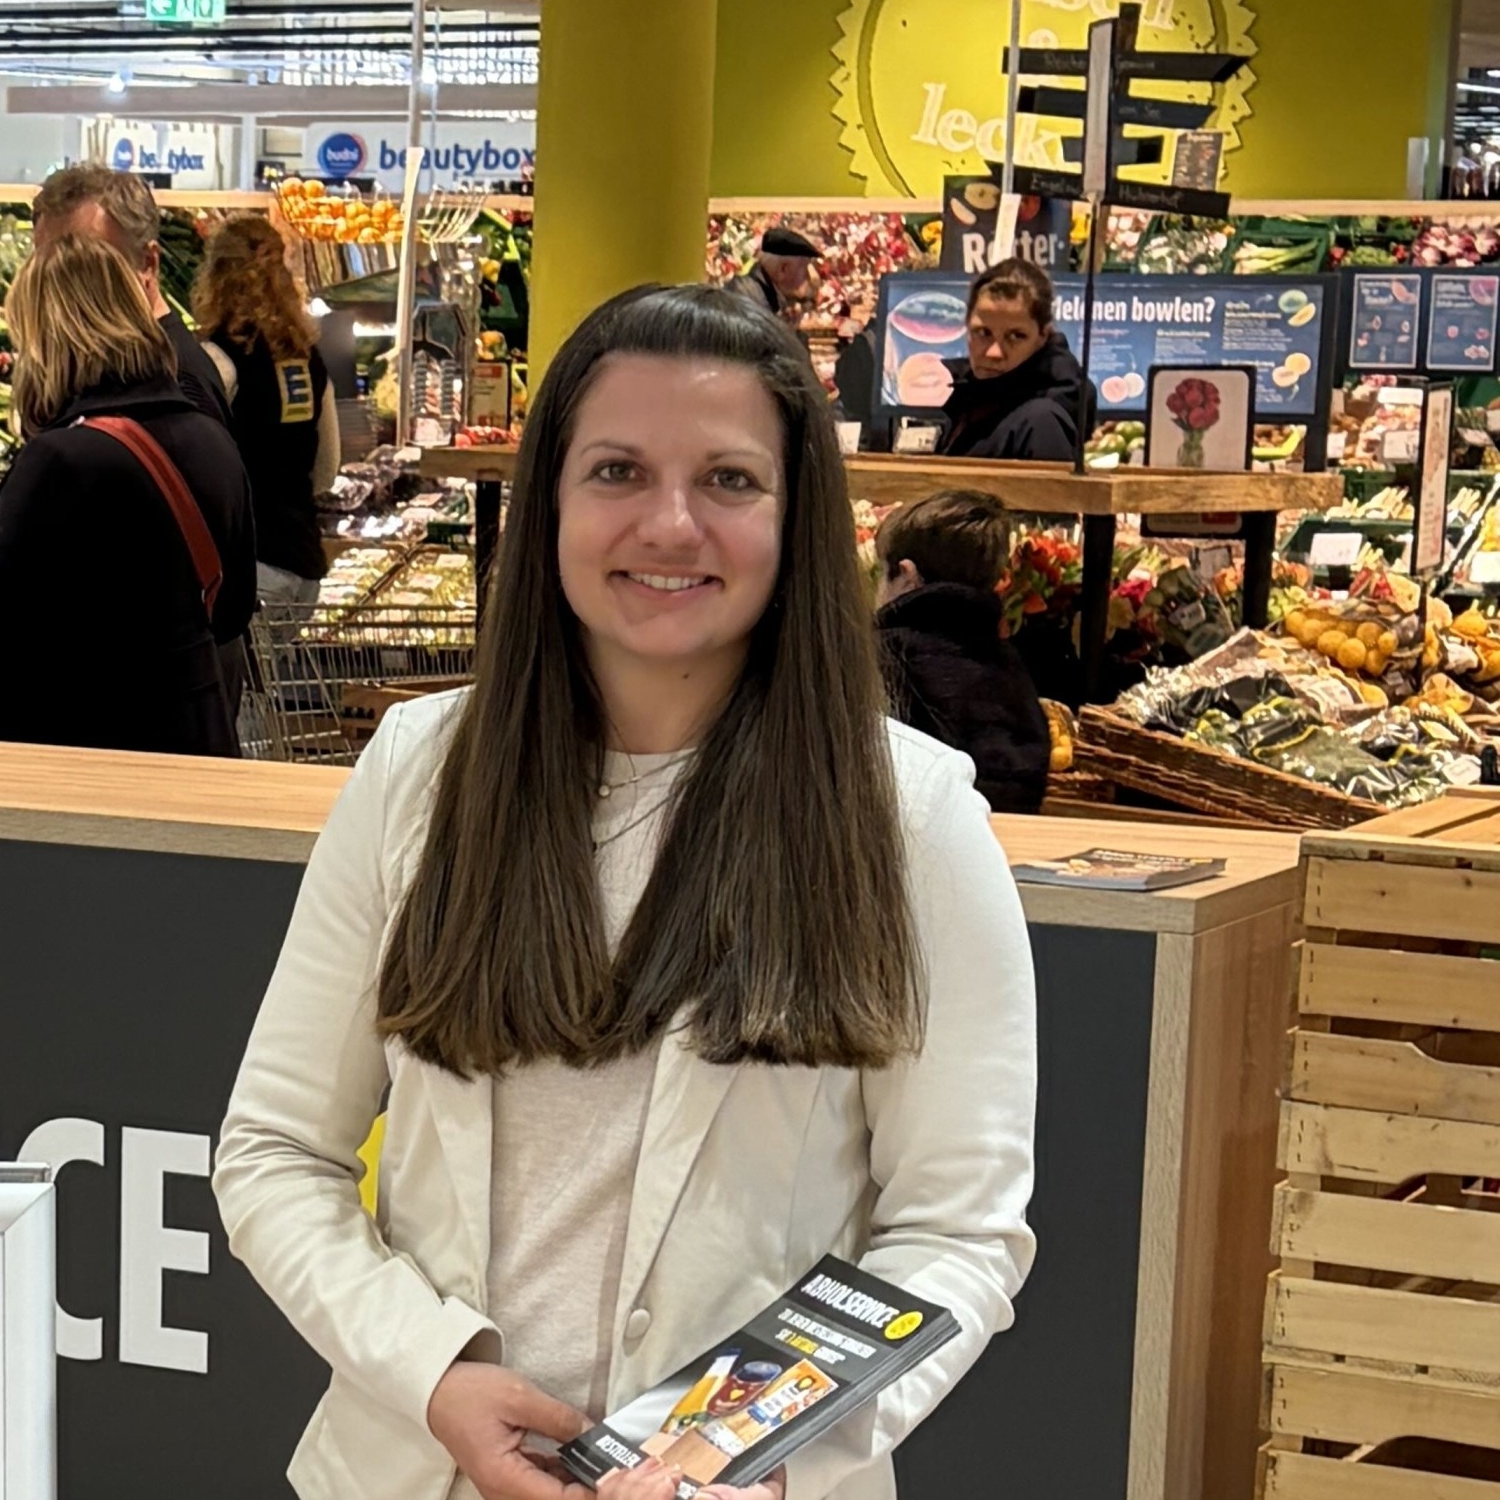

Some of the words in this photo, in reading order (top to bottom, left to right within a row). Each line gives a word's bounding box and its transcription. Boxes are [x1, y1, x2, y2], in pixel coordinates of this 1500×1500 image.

[911, 81, 1064, 170] leck
[139, 144, 204, 174] betybox
[1052, 296, 1127, 322] elnen
[1131, 296, 1216, 323] bowlen?
[801, 1273, 900, 1329] ABHOLSERVICE
